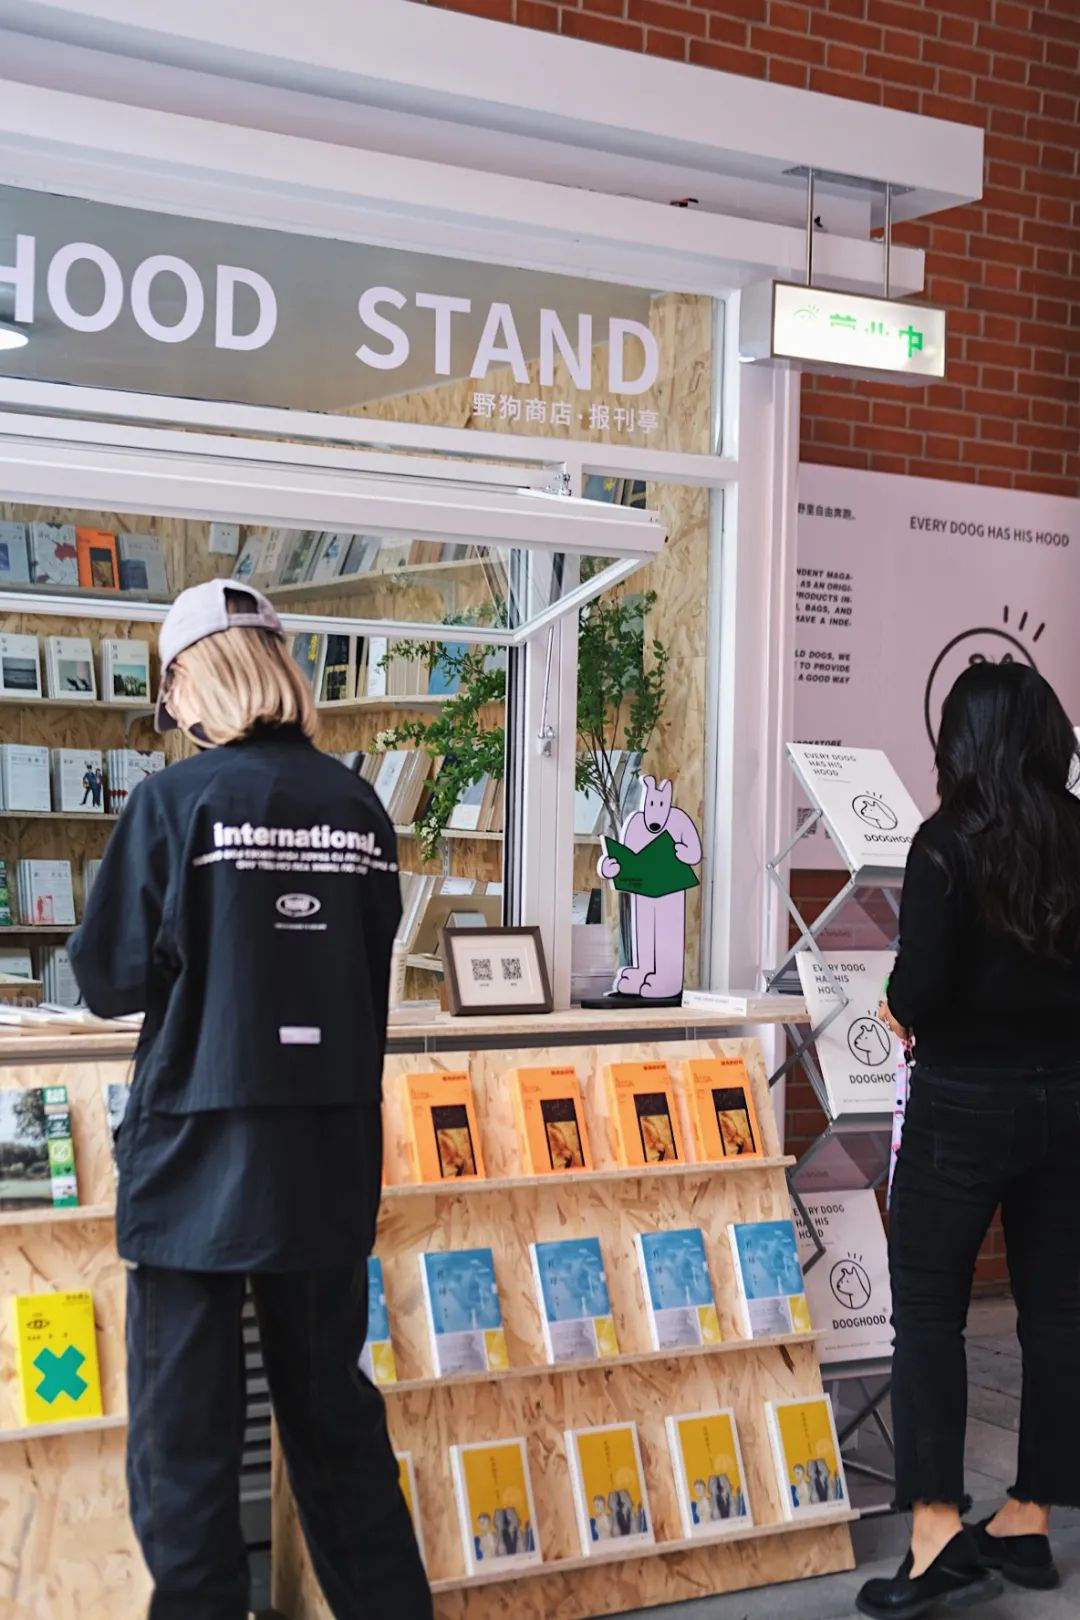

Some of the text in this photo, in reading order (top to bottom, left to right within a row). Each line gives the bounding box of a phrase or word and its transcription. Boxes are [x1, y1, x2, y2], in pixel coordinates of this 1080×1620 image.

[355, 286, 659, 395] STAND
[910, 516, 1070, 547] EVERY DOOG HAS HIS HOOD
[835, 607, 852, 615] AND
[820, 617, 825, 625] A
[800, 661, 850, 673] TO PROVIDE
[805, 674, 830, 683] GOOD
[832, 676, 850, 684] WAY
[864, 834, 912, 844] DOOGHOO
[812, 963, 866, 972] EVRY DOOG
[834, 974, 850, 983] HIS
[849, 1072, 896, 1084] DOOGHOO
[793, 1204, 845, 1217] ERY DOOG
[815, 1217, 829, 1226] HIS
[798, 1229, 824, 1239] HOD
[832, 1315, 886, 1330] DOOGHOOD
